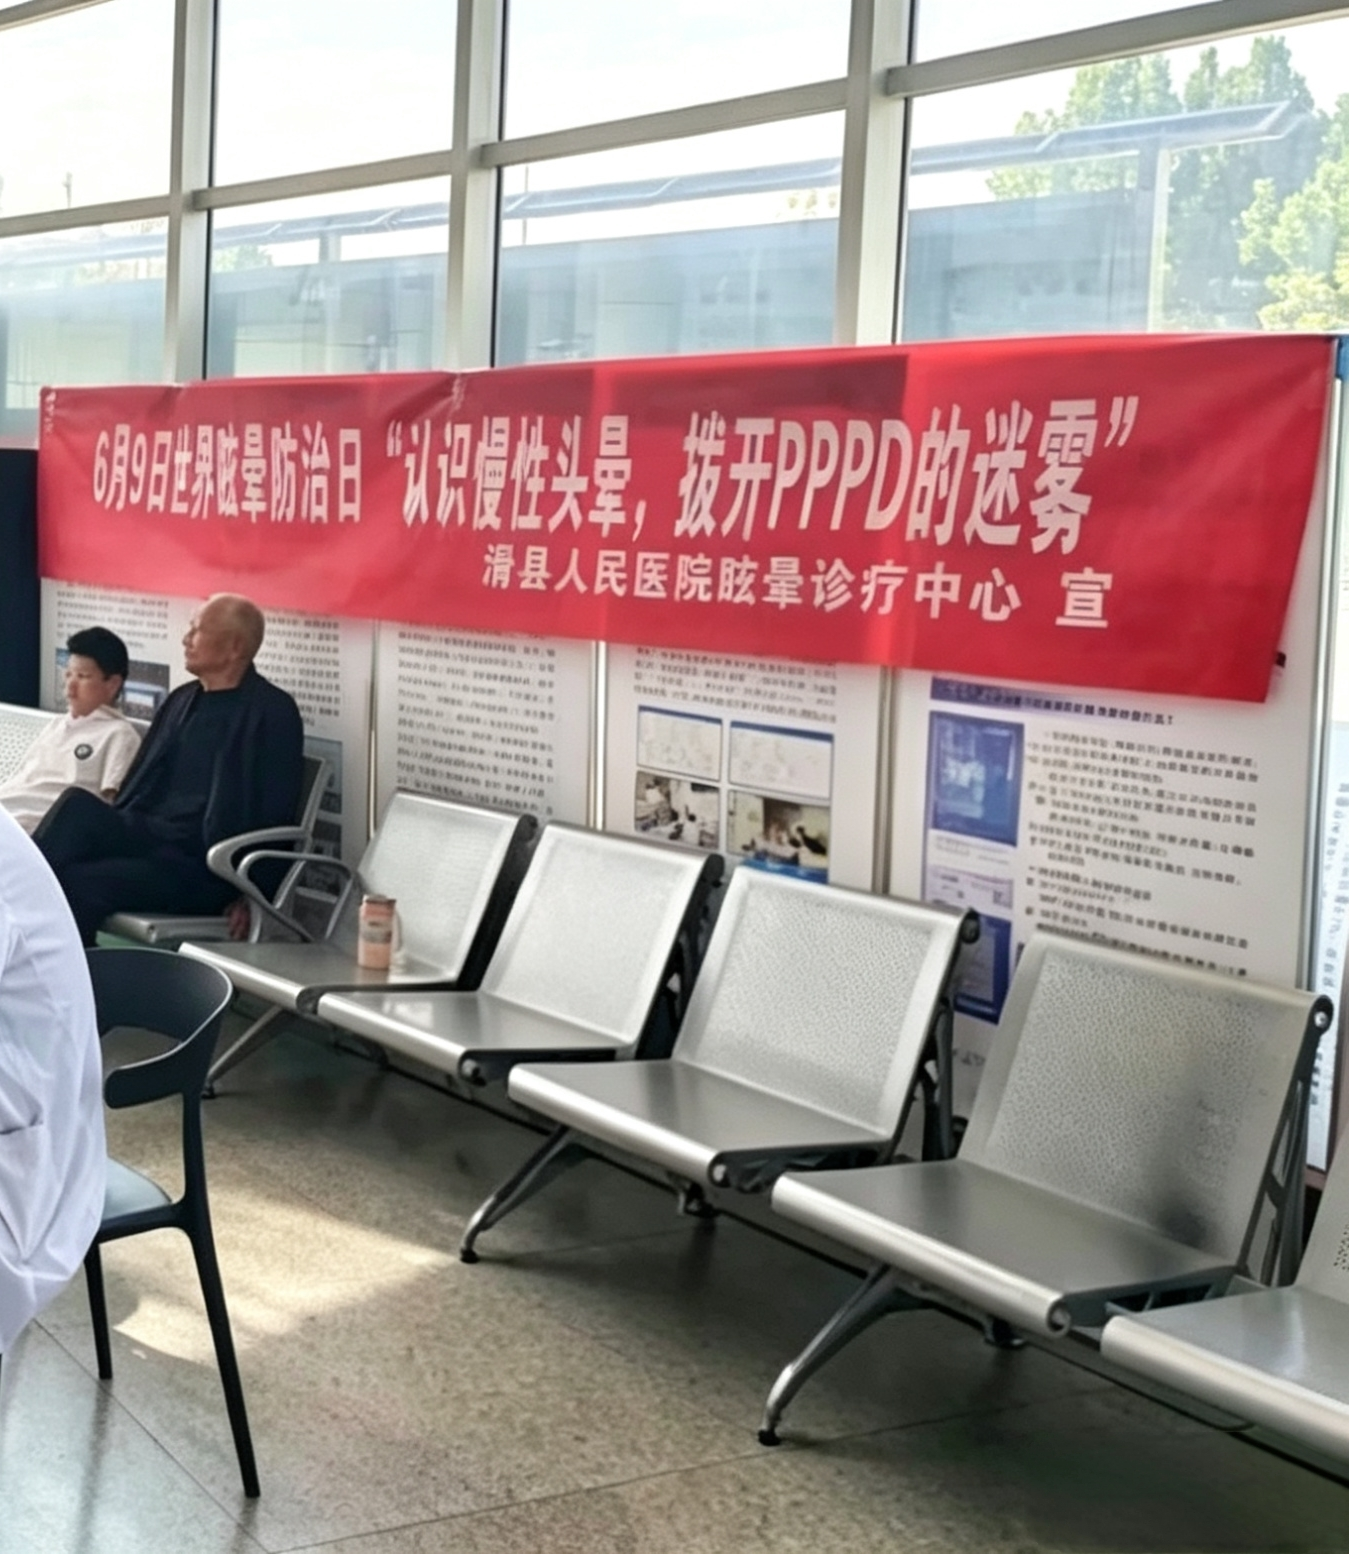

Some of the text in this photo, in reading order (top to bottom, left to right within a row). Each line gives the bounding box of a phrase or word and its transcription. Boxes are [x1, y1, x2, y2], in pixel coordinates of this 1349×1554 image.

[93, 421, 361, 523] 6月9日世界眩晕防治日
[482, 543, 1113, 628] 滑县人民医院眩晕诊疗中心 宣
